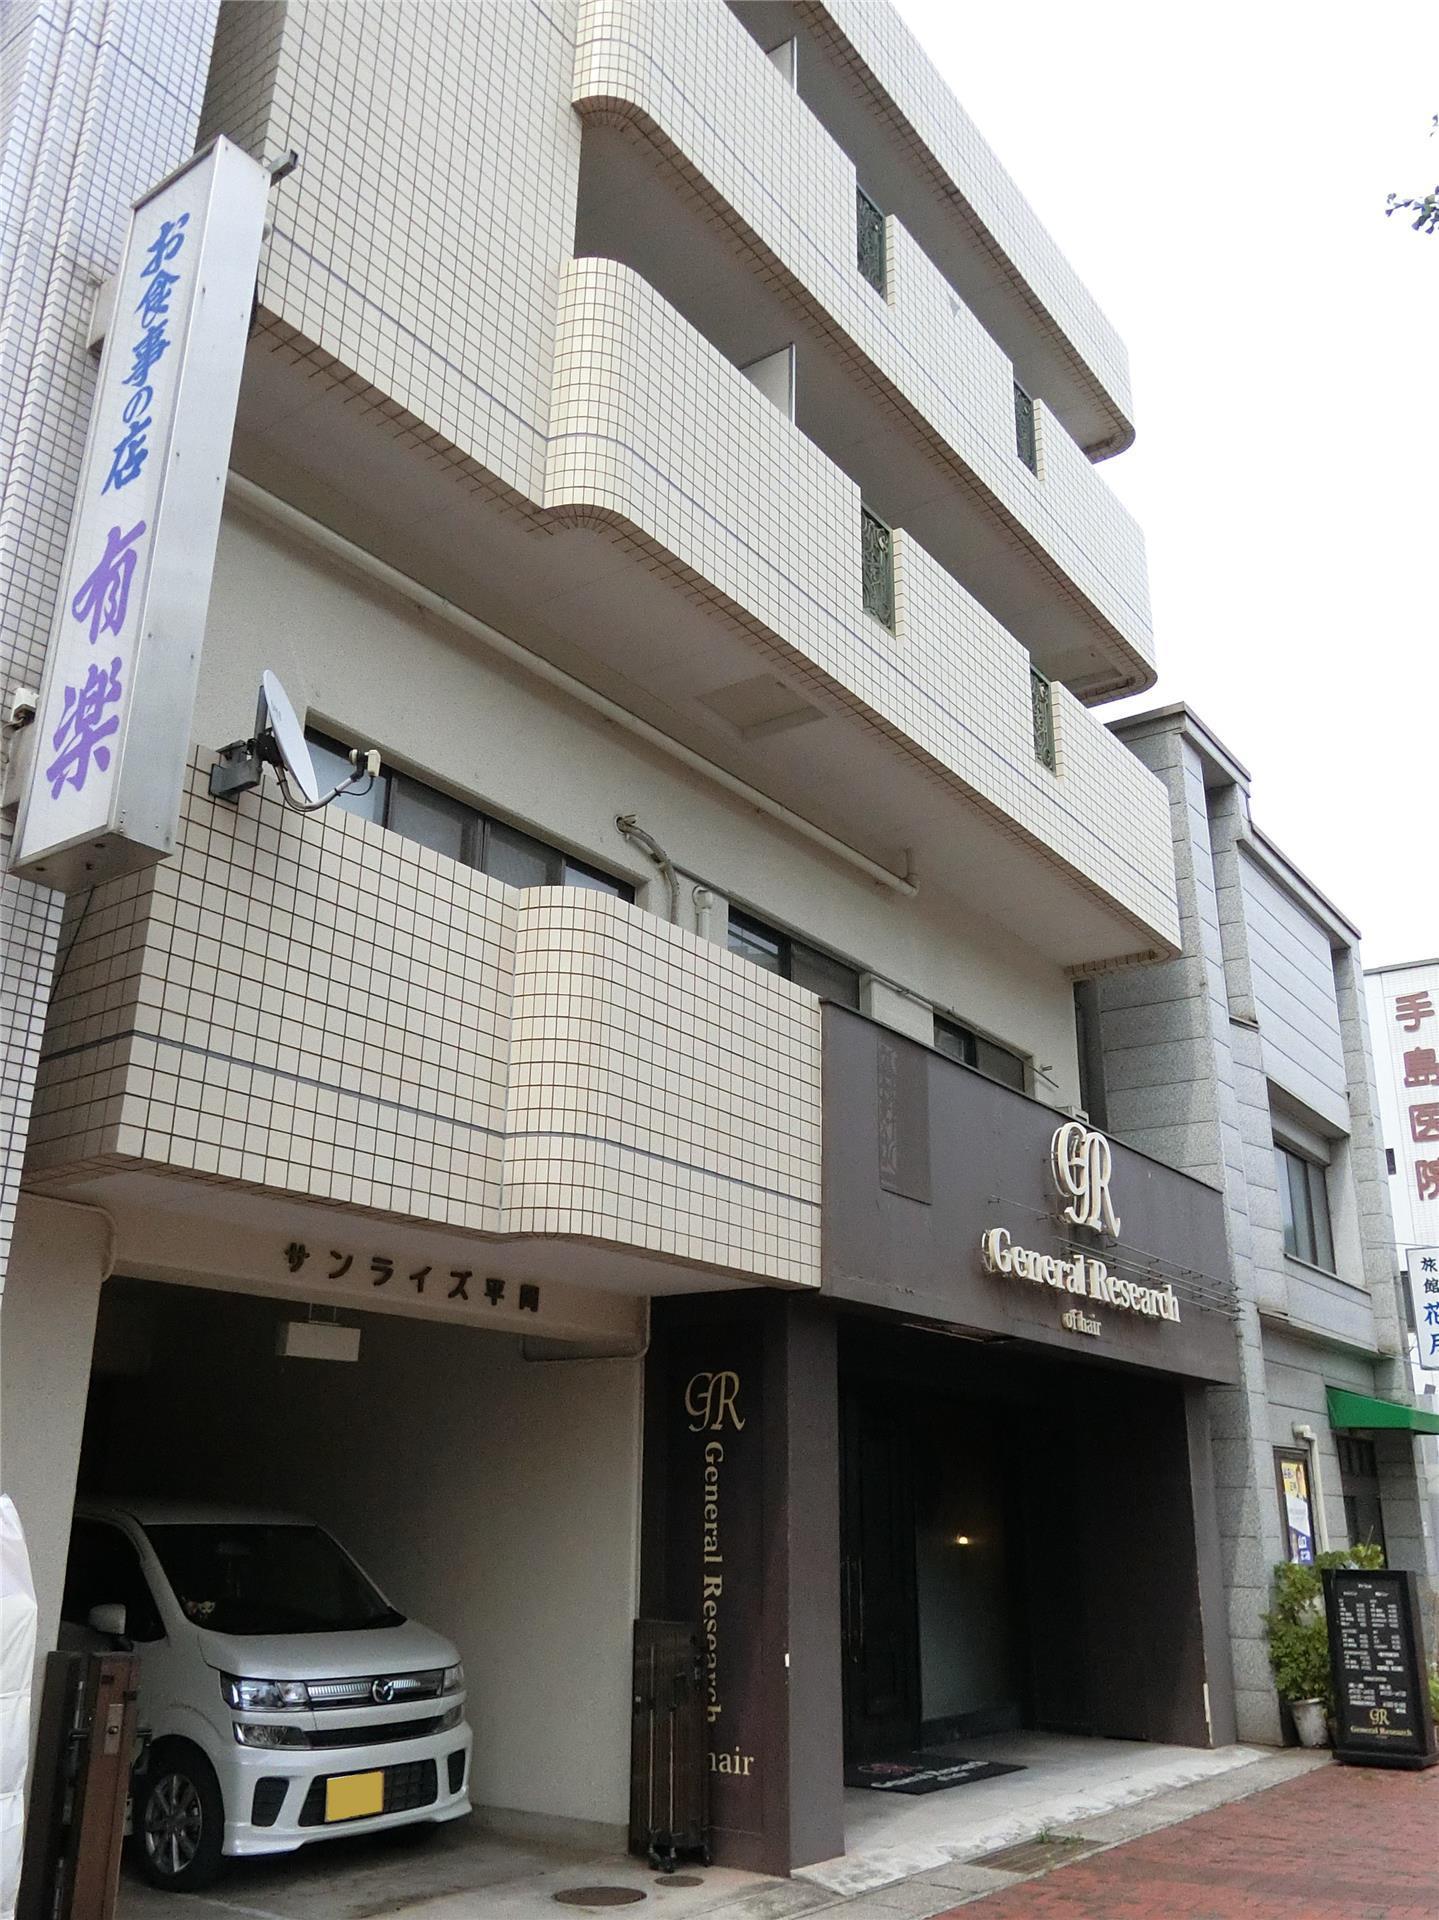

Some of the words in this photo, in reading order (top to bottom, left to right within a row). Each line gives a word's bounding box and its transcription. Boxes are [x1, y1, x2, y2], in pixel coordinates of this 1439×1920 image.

[102, 212, 190, 496] お食事の店
[46, 520, 147, 800] 有楽
[982, 1227, 1086, 1296] General
[1087, 1258, 1181, 1323] Research
[1061, 1308, 1079, 1331] of
[1079, 1311, 1101, 1337] hair
[684, 1371, 746, 1432] GR
[704, 1441, 724, 1563] General
[703, 1574, 723, 1723] Research
